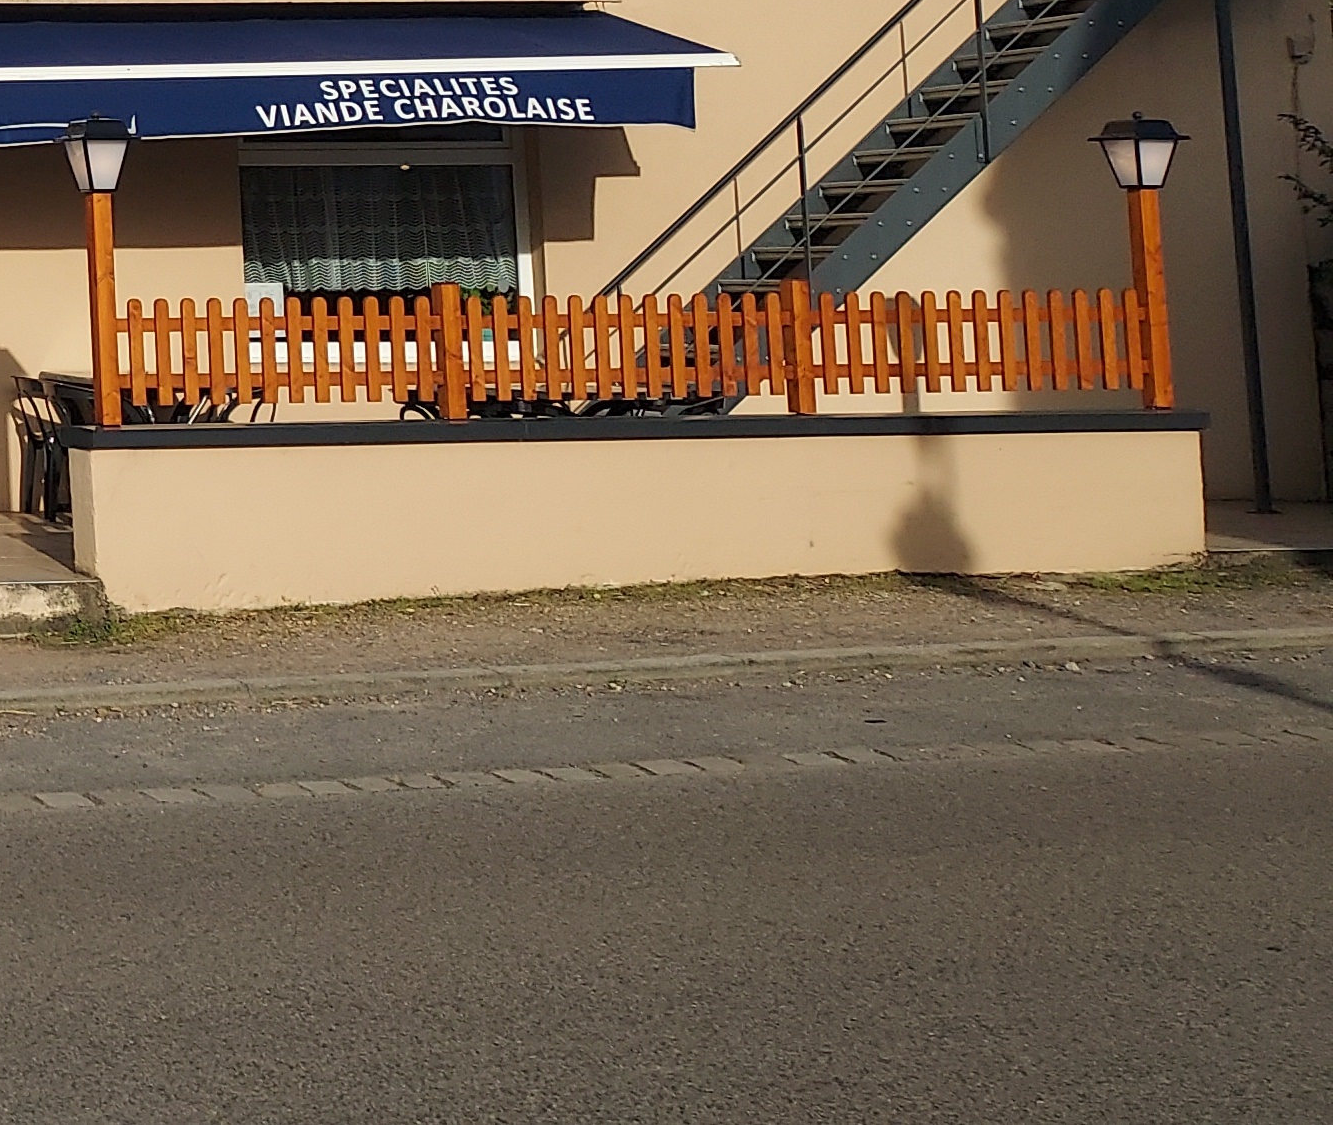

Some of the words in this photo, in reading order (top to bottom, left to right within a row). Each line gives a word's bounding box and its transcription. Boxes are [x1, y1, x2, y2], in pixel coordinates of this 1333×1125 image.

[319, 76, 519, 100] SPECIALITES
[255, 97, 385, 128] VIANDE
[393, 95, 595, 122] CHAROLAISE
